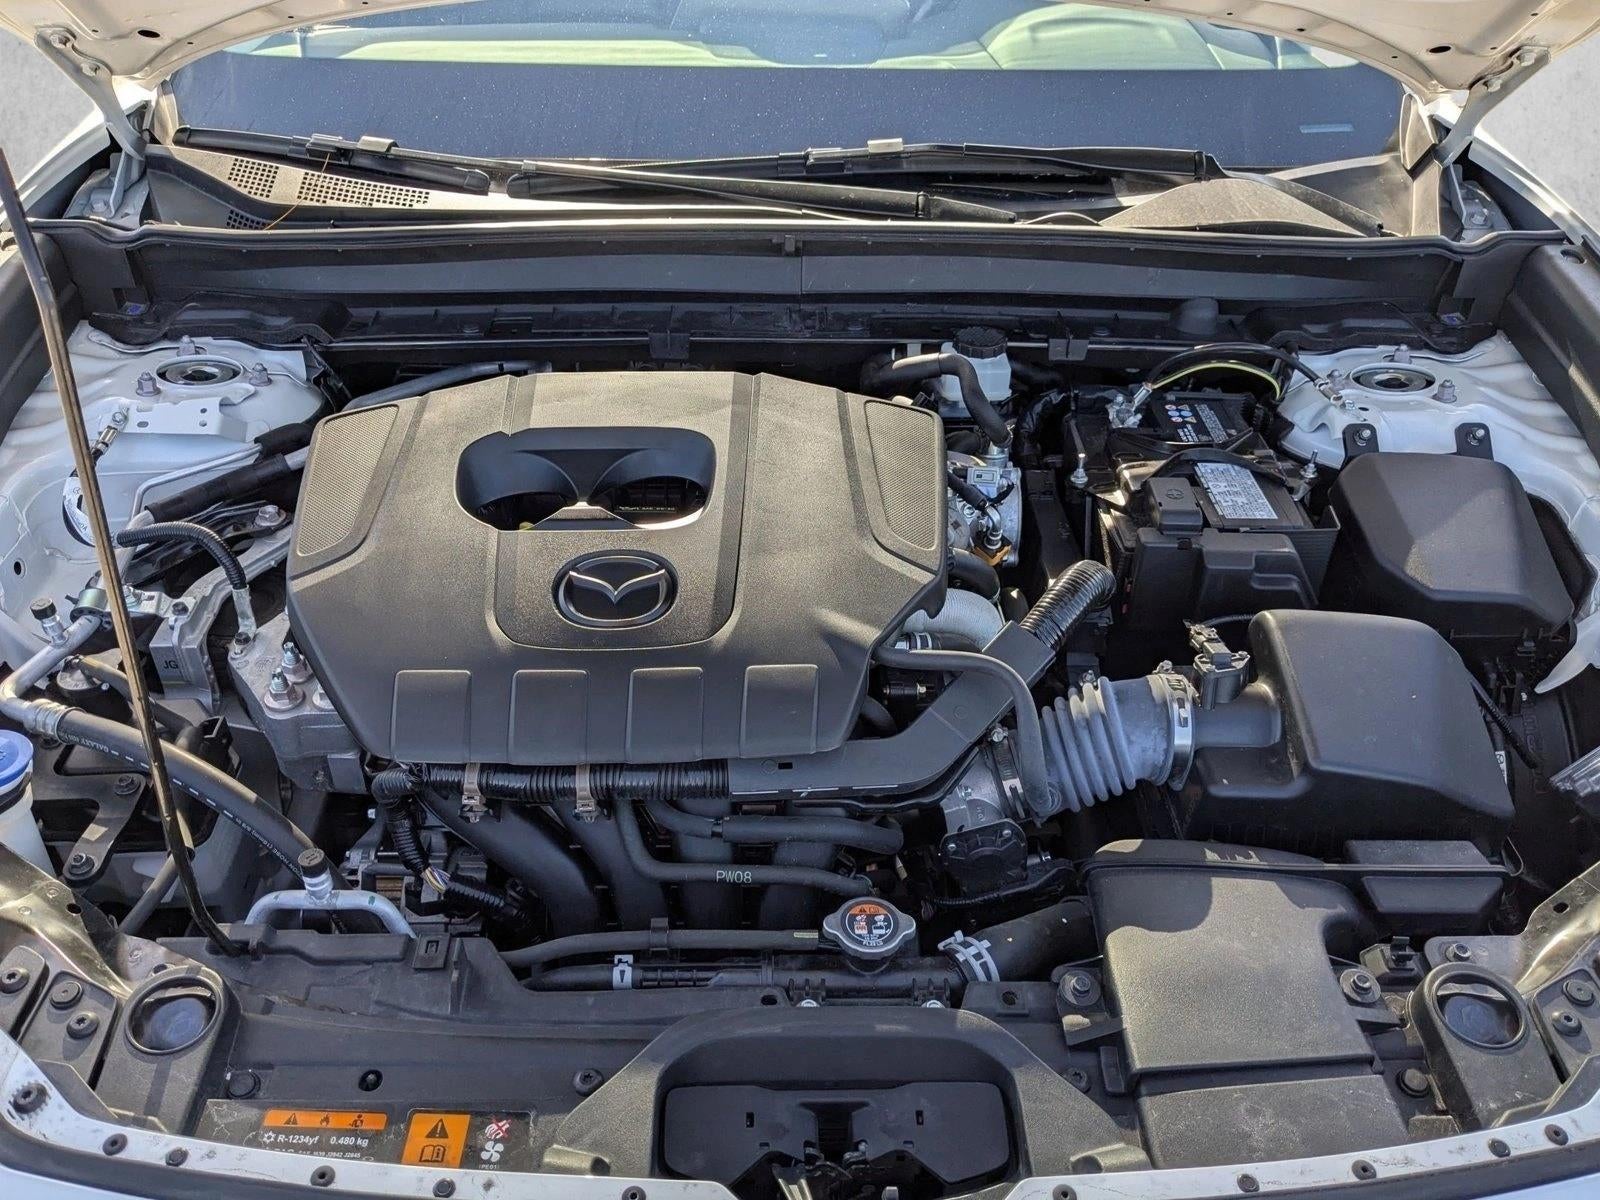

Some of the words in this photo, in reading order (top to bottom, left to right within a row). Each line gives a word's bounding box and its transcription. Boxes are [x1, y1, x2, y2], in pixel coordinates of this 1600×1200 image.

[163, 660, 178, 669] JG
[716, 870, 752, 883] PW08
[277, 1134, 320, 1146] R-1234yf
[330, 1136, 355, 1146] 0.480
[356, 1137, 369, 1148] kg
